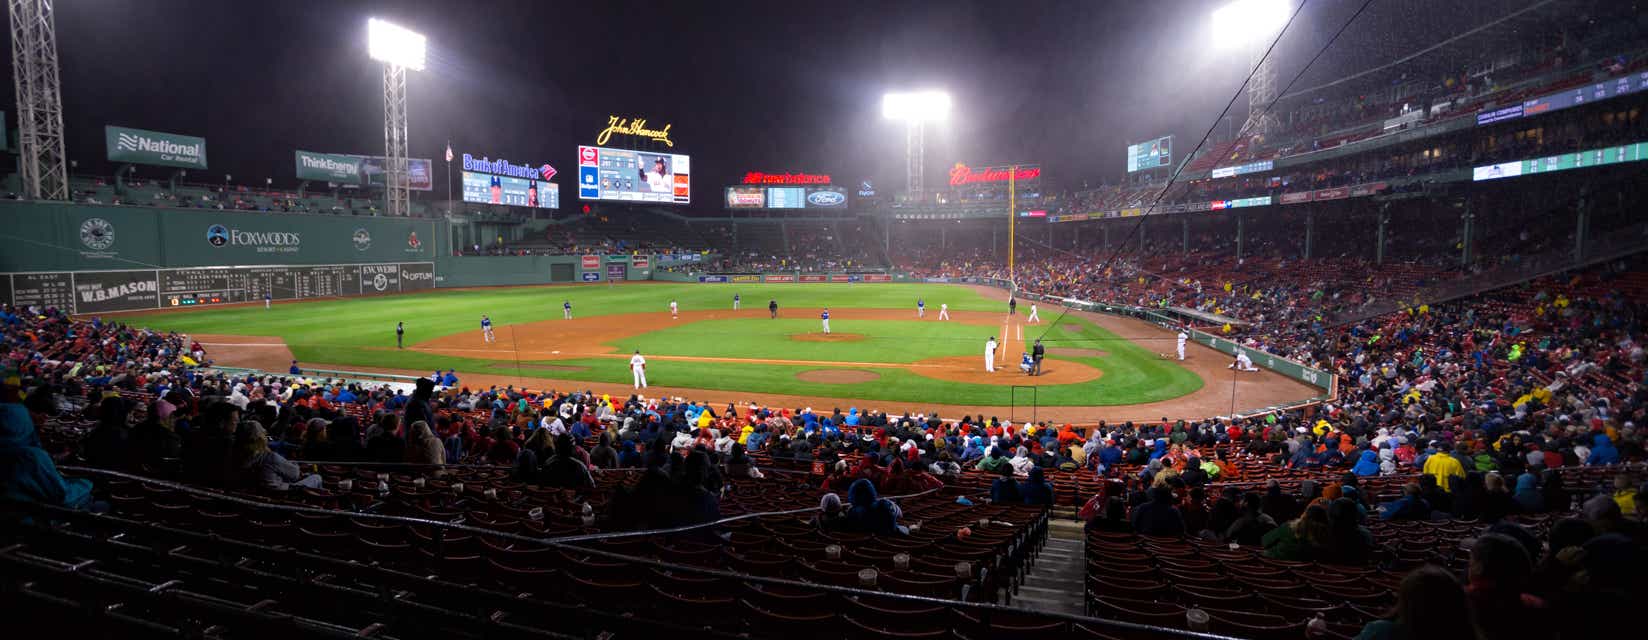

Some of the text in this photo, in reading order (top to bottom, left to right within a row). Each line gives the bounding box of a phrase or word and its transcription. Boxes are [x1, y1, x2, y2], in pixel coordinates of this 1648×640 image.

[597, 115, 673, 147] John Hancock
[138, 137, 200, 156] National
[301, 155, 358, 175] ThinkEnergy
[463, 153, 539, 179] Bank of America
[950, 166, 1040, 185] Budweser
[231, 230, 300, 246] FOXWOODS
[409, 272, 433, 280] OPTUM
